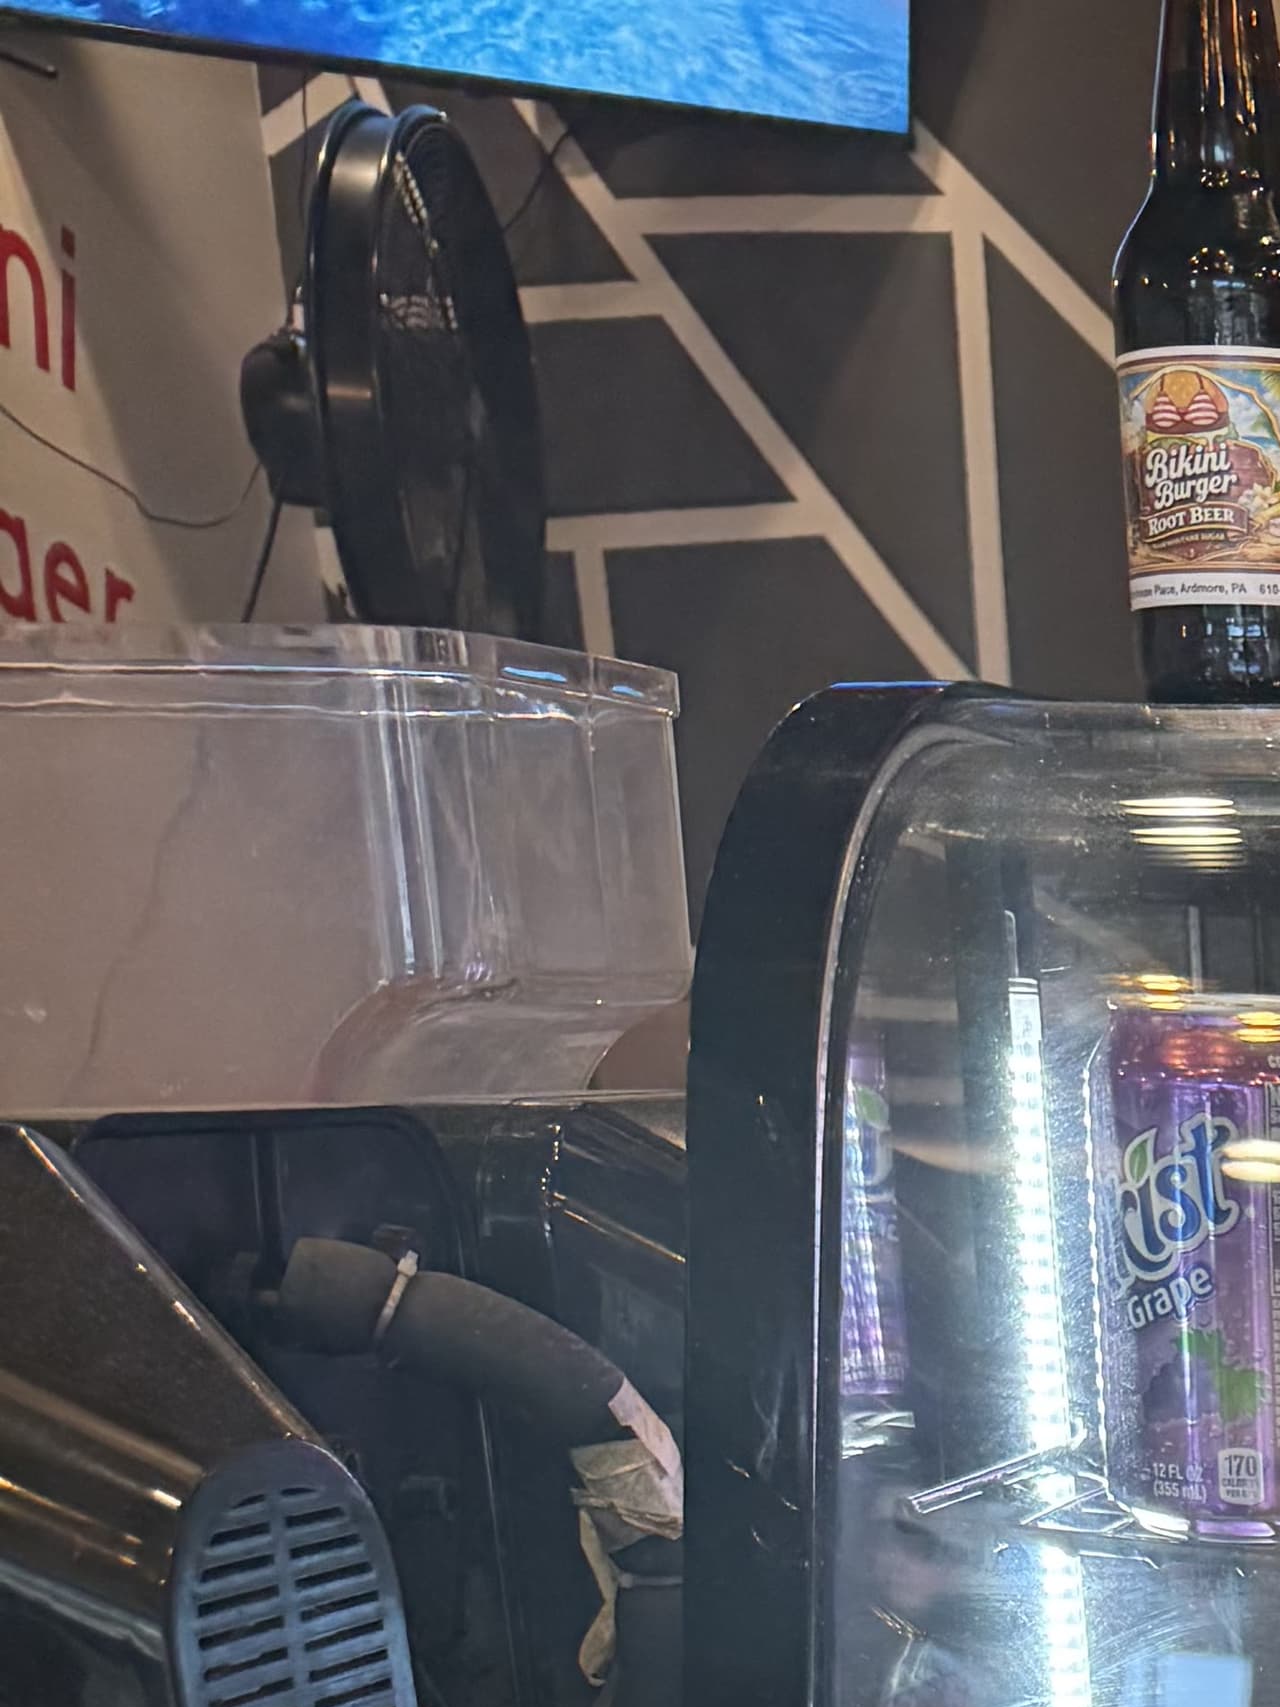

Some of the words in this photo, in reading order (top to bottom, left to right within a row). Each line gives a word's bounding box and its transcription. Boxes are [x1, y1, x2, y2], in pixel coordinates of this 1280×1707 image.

[1145, 443, 1232, 488] Bikini
[1154, 472, 1238, 509] Burger
[1148, 514, 1186, 536] ROOT
[1190, 506, 1234, 524] BEER
[1231, 584, 1247, 595] PA
[1127, 1263, 1214, 1329] Grape
[1152, 1463, 1166, 1477] 12
[1224, 1455, 1257, 1477] 170
